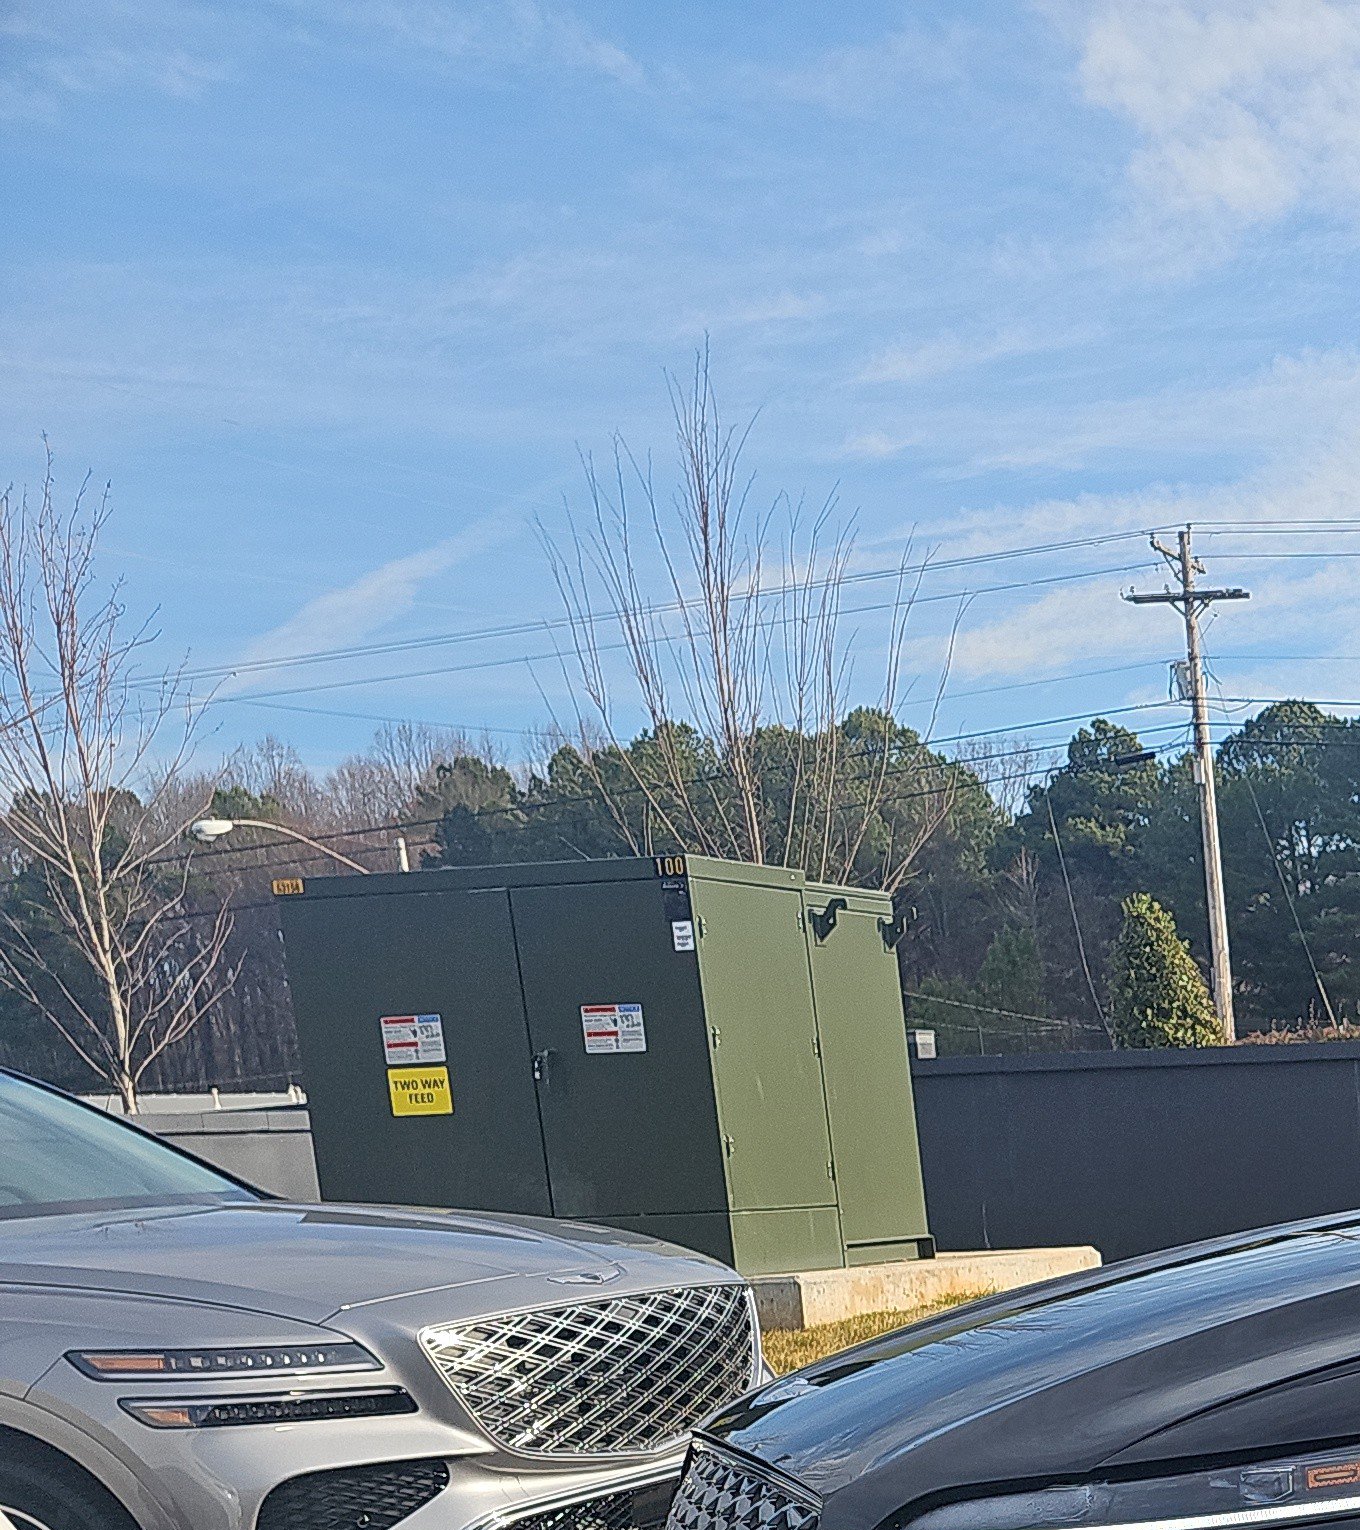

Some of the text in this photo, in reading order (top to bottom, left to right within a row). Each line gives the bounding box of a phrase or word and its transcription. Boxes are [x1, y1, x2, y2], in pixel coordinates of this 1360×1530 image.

[656, 857, 684, 877] 100
[393, 1078, 446, 1091] TWO WAY
[408, 1092, 434, 1105] FEED
